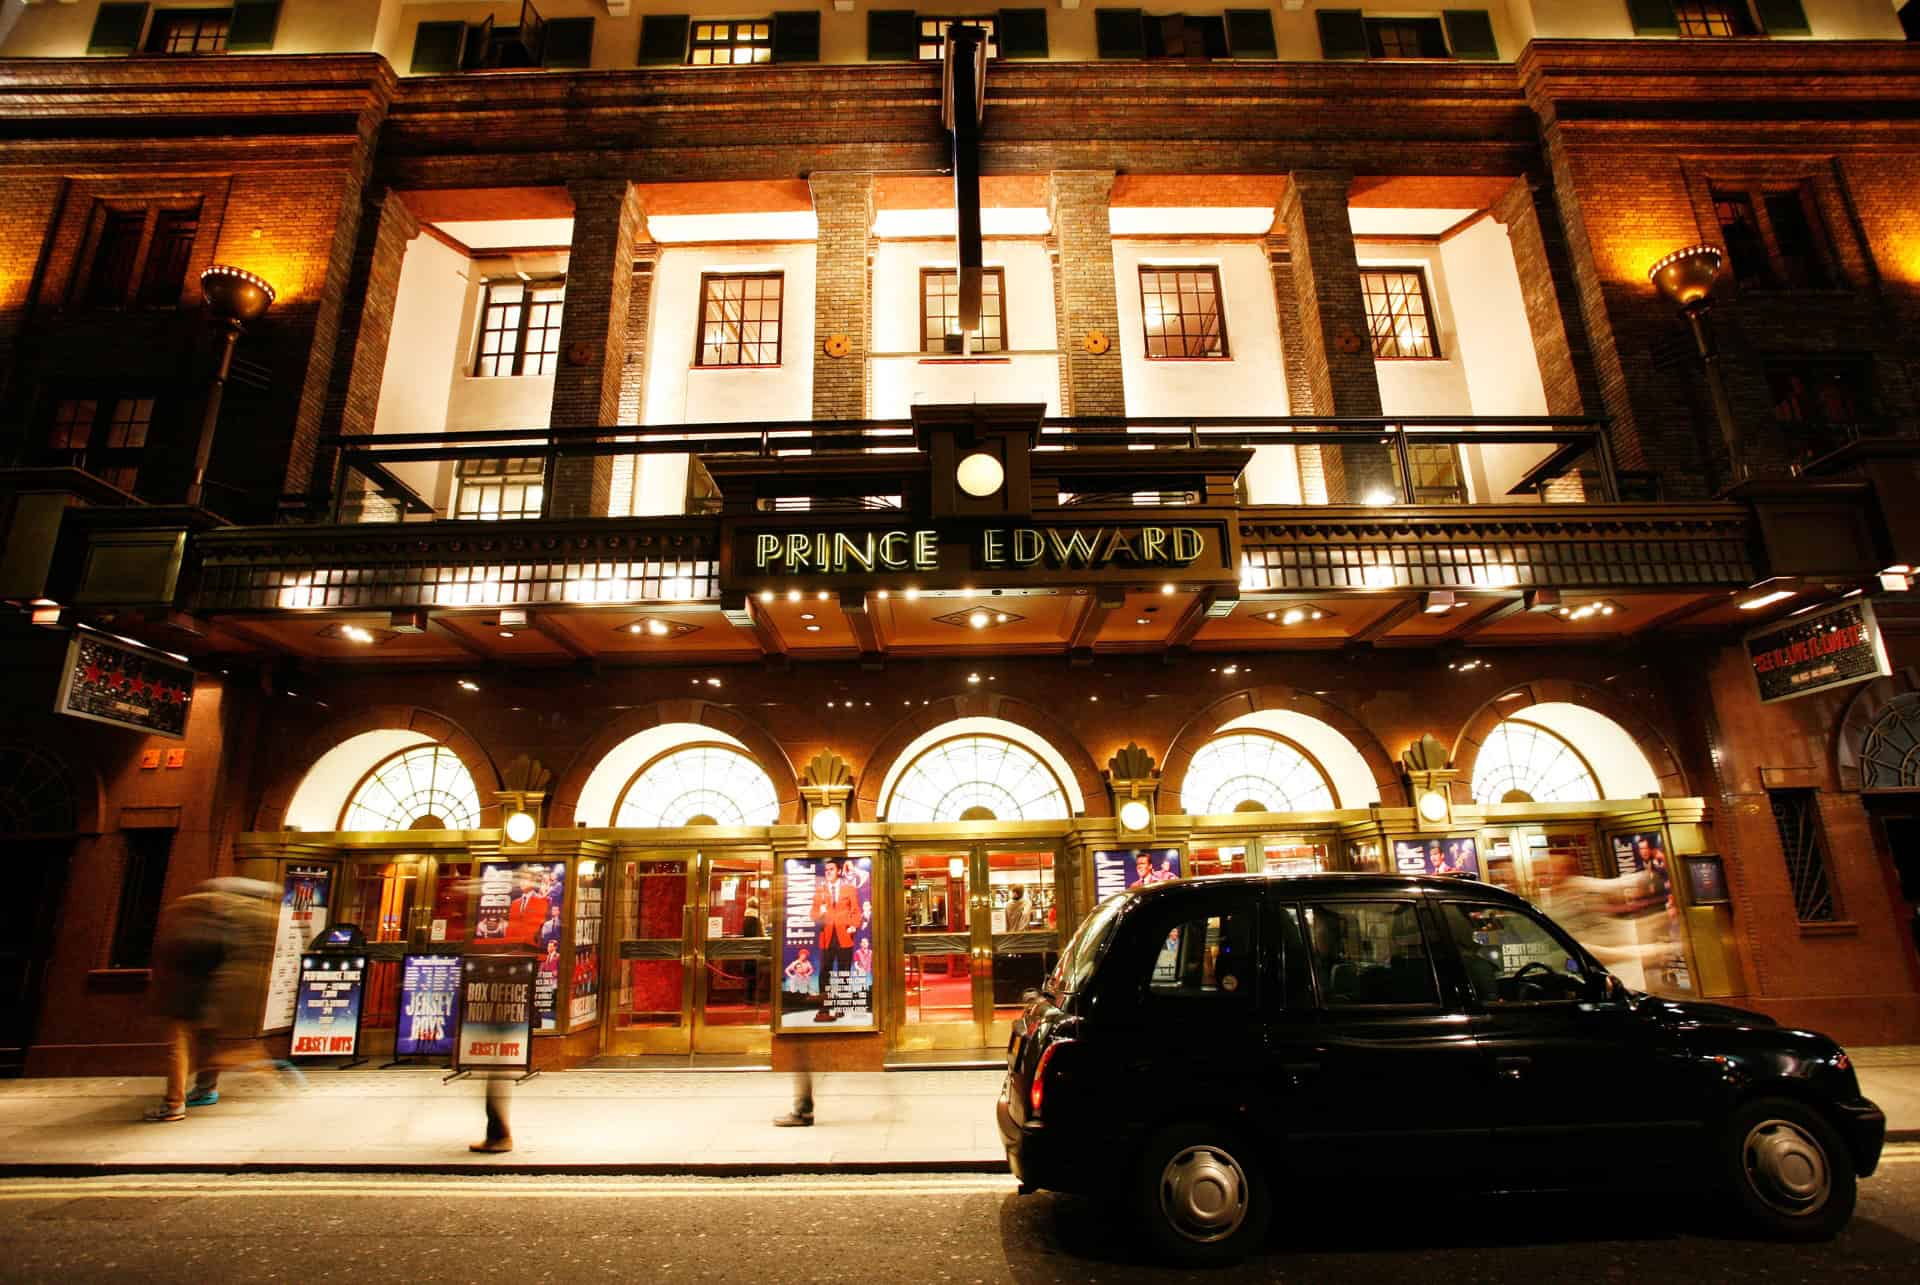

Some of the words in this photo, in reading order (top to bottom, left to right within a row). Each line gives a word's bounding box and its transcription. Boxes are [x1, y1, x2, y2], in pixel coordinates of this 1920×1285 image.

[756, 530, 938, 571] PRINCE
[984, 527, 1205, 567] EDWARD
[1398, 845, 1424, 875] ICK
[1097, 860, 1125, 901] MMY
[786, 863, 816, 938] FRANKIE
[406, 991, 455, 1016] JERSEY
[467, 983, 489, 1002] BOX
[491, 984, 528, 1003] OFFICE
[468, 1002, 493, 1022] NOW
[496, 1003, 525, 1022] OPEN
[409, 1015, 445, 1040] BOYS
[295, 1037, 328, 1052] JERSEY
[330, 1037, 353, 1052] BOYS
[470, 1042, 497, 1056] JERSEY
[499, 1042, 520, 1056] BOYS
